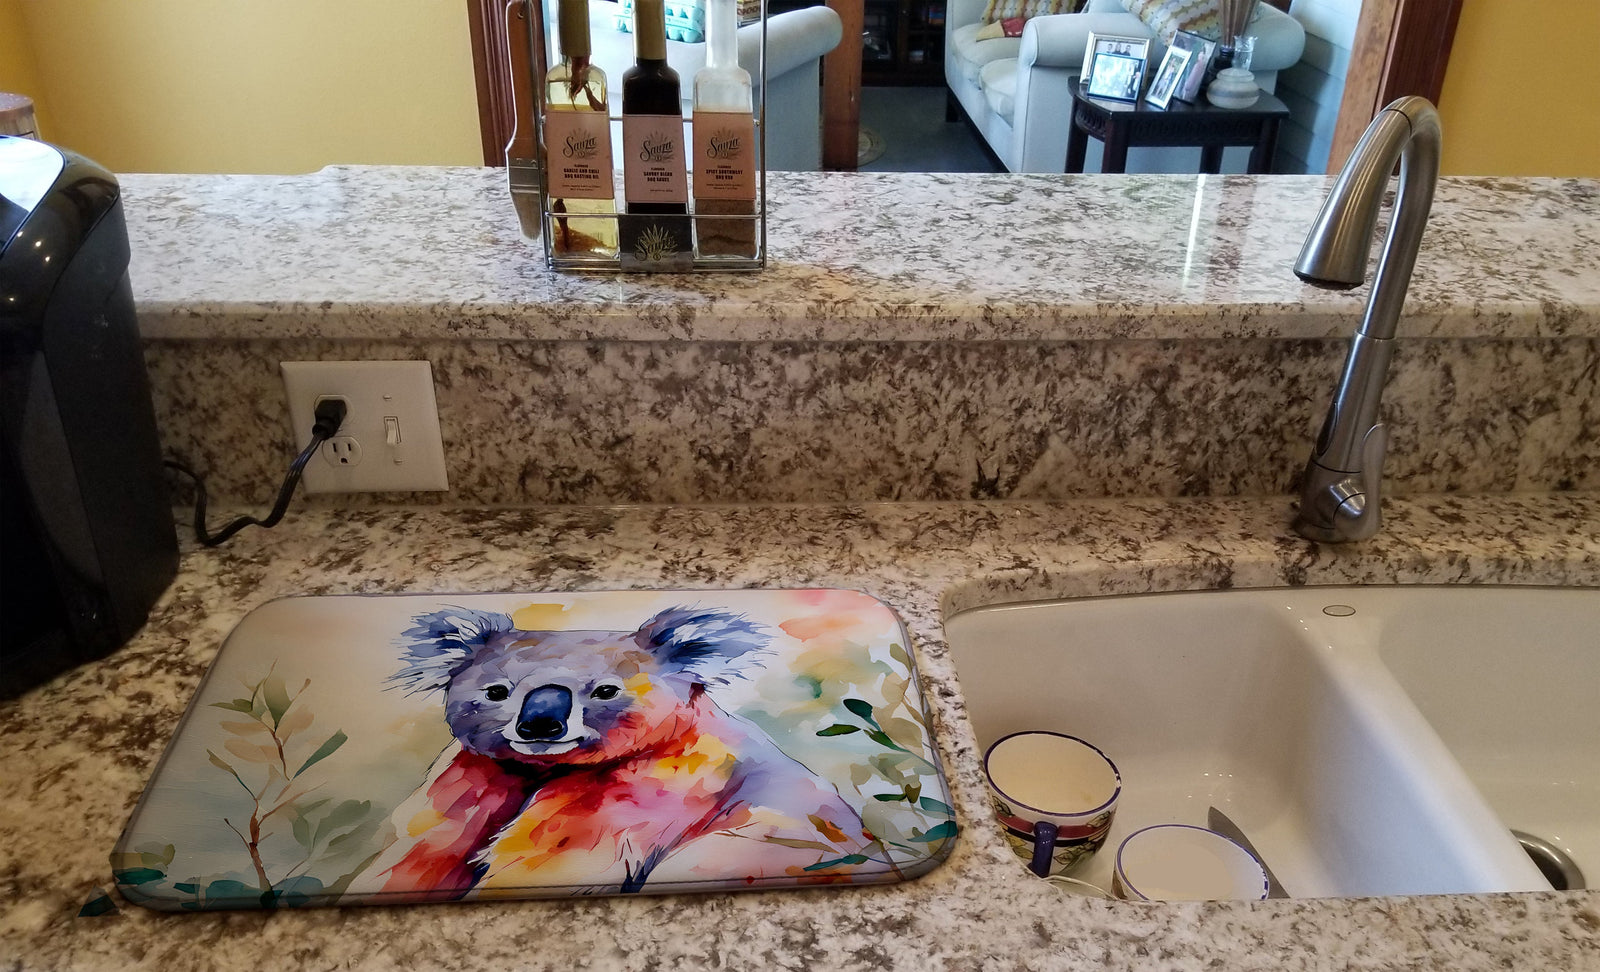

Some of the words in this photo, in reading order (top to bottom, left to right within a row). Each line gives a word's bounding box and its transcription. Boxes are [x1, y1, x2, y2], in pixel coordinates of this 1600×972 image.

[563, 136, 597, 158] Sauza
[640, 140, 674, 161] Sauza
[707, 136, 740, 159] Sauza
